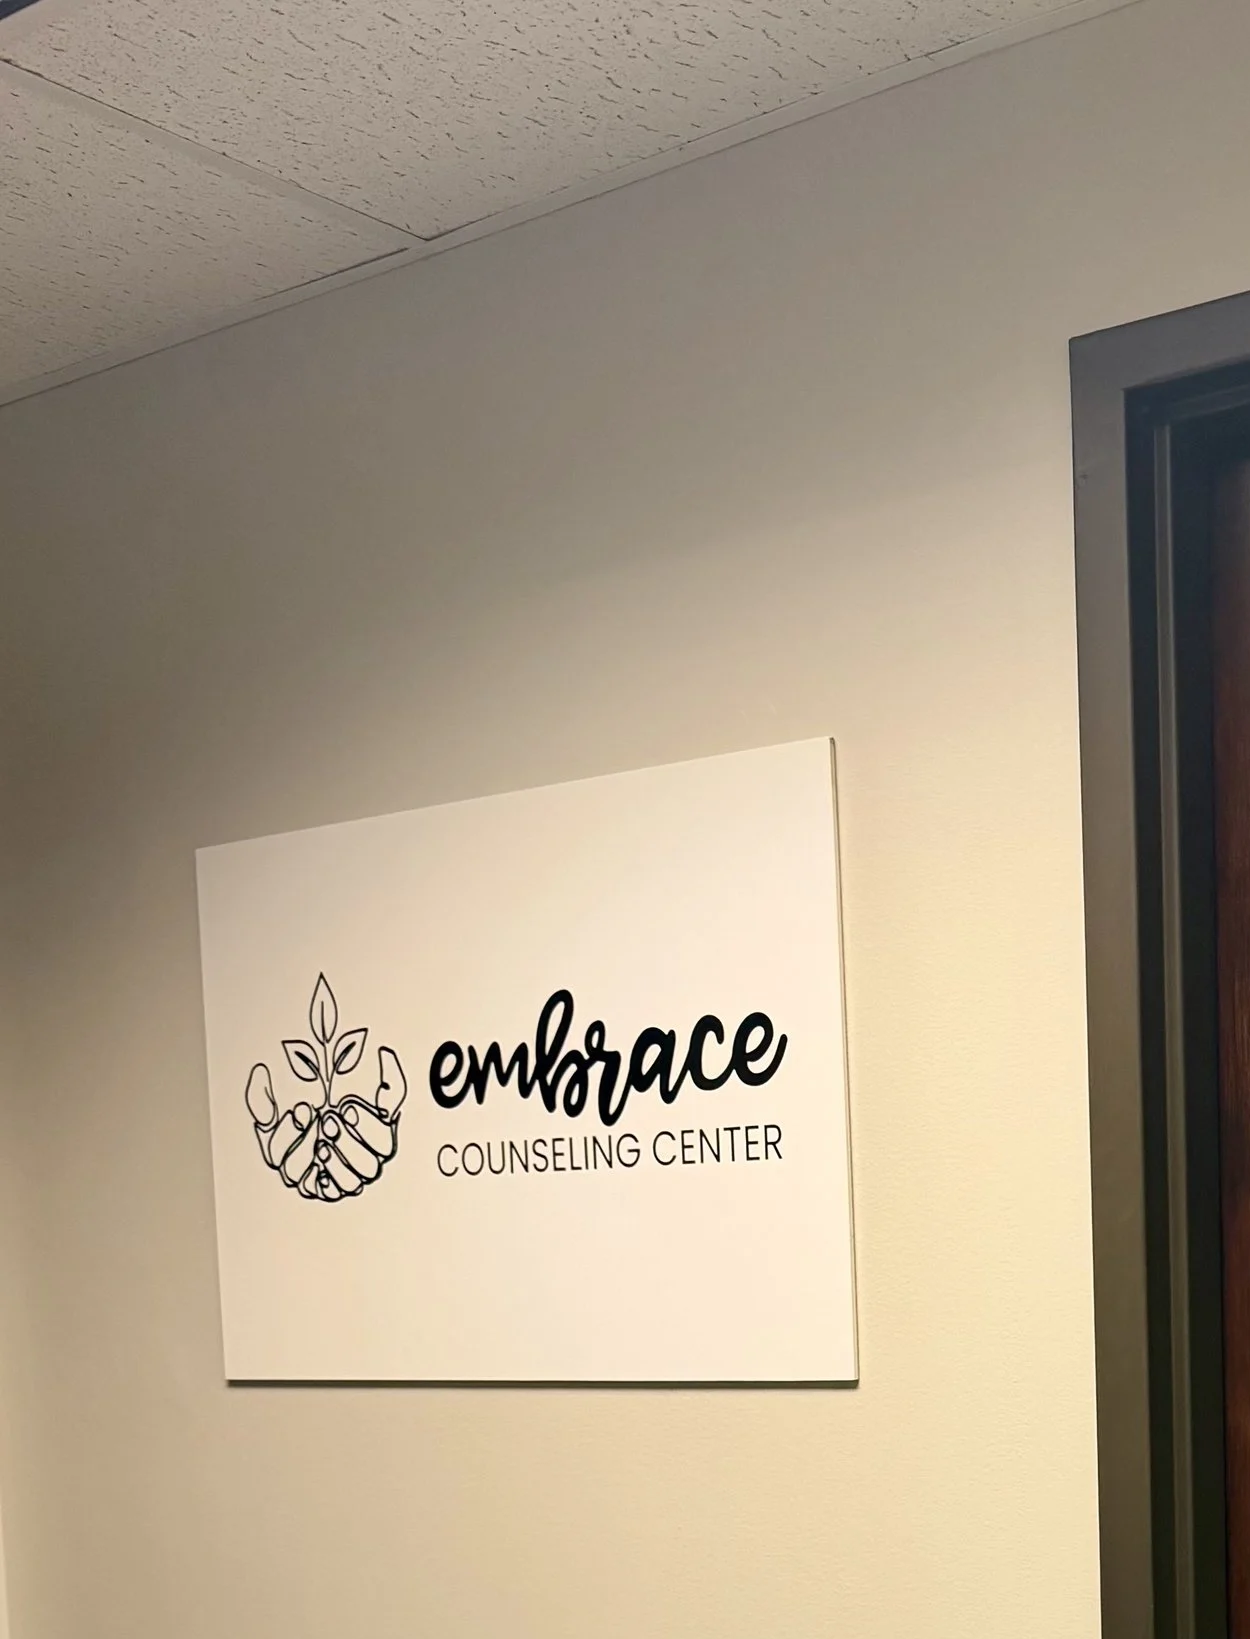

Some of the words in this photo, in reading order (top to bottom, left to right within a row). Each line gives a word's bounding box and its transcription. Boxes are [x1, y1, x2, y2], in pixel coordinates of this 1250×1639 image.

[429, 989, 788, 1126] embrace
[437, 1133, 641, 1177] COUNSELING
[652, 1124, 783, 1167] CENTER
